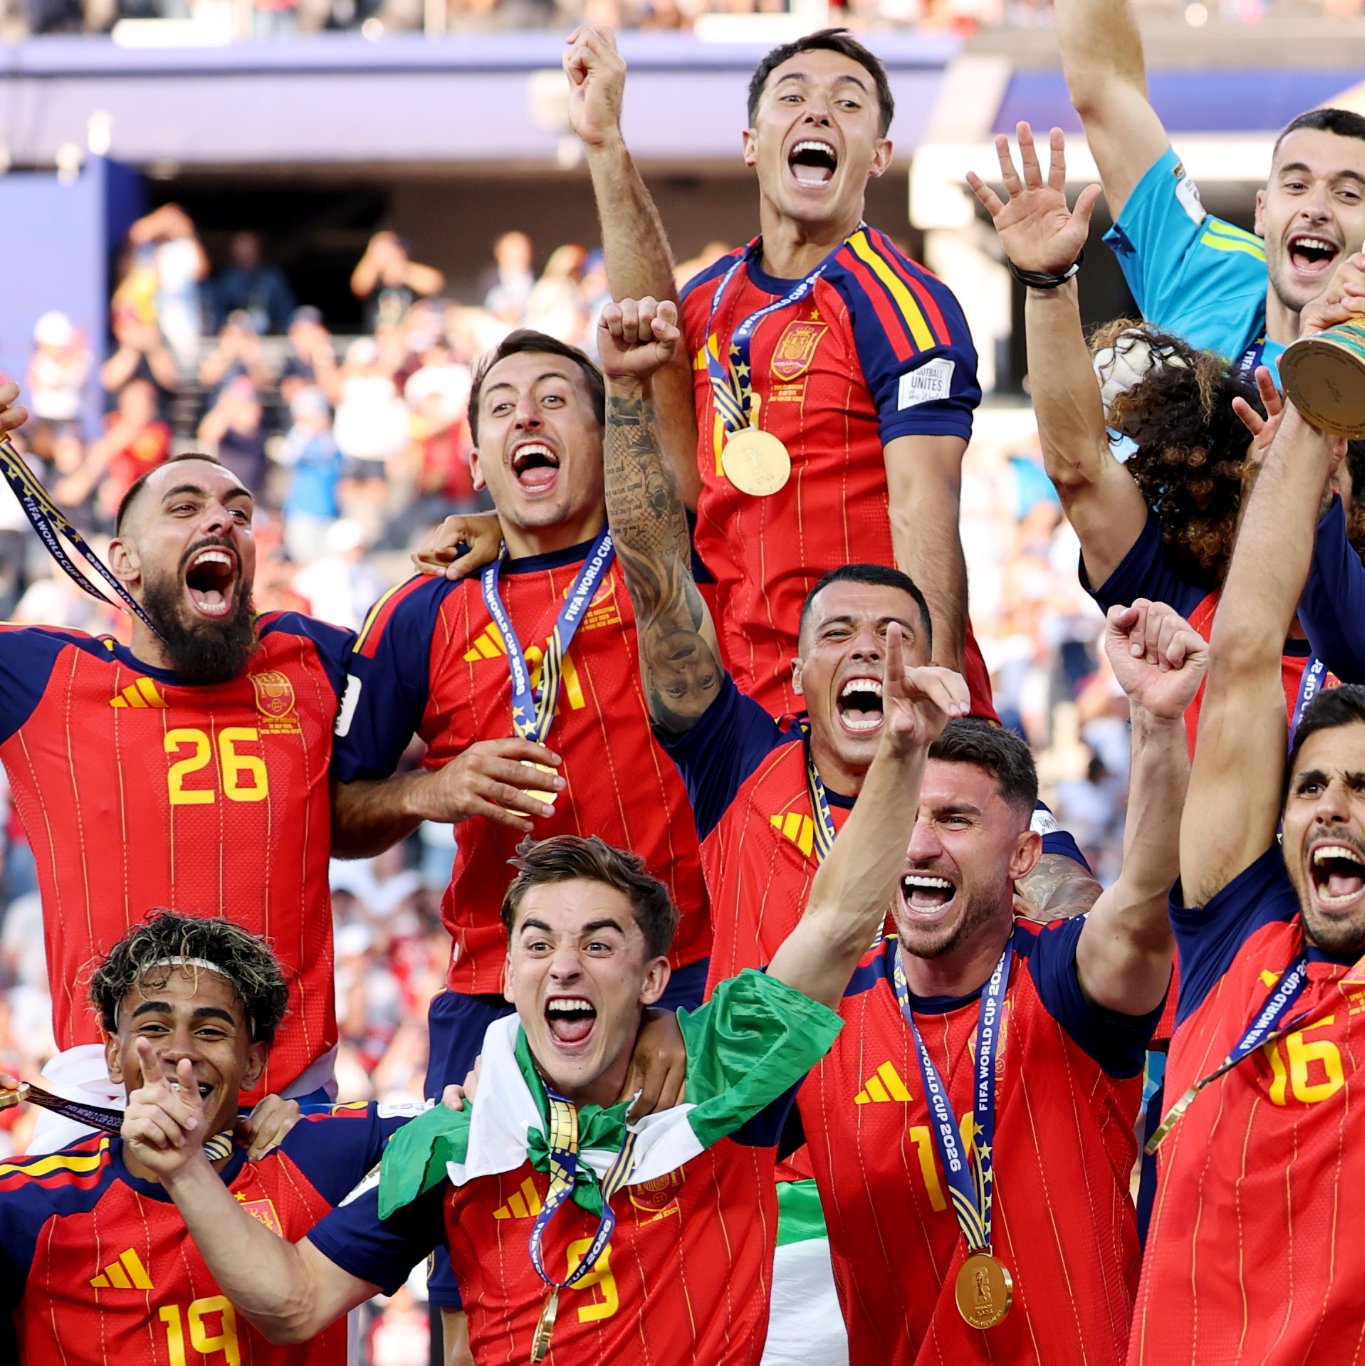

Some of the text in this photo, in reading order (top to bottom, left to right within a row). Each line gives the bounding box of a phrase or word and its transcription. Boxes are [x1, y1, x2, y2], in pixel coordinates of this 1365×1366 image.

[911, 377, 943, 392] UNITES
[23, 497, 42, 521] FIFA
[37, 520, 63, 560] WORLD
[563, 594, 586, 623] FIFA
[577, 556, 604, 596] WORLD
[598, 535, 614, 563] CUP
[485, 592, 509, 632] WORLD
[505, 632, 519, 656] CUP
[510, 655, 526, 697] 2026
[1303, 674, 1317, 701] CUP
[163, 727, 270, 805] 26
[983, 996, 997, 1026] CUP
[1239, 973, 1301, 1051] FIFA WORLD CUP
[979, 1024, 993, 1079] WORLD
[1263, 1015, 1345, 1106] 16
[920, 1044, 962, 1173] WORLD CUP 2026
[979, 1080, 989, 1112] FIFA
[586, 1218, 612, 1267] 2026
[565, 1236, 619, 1324] 9
